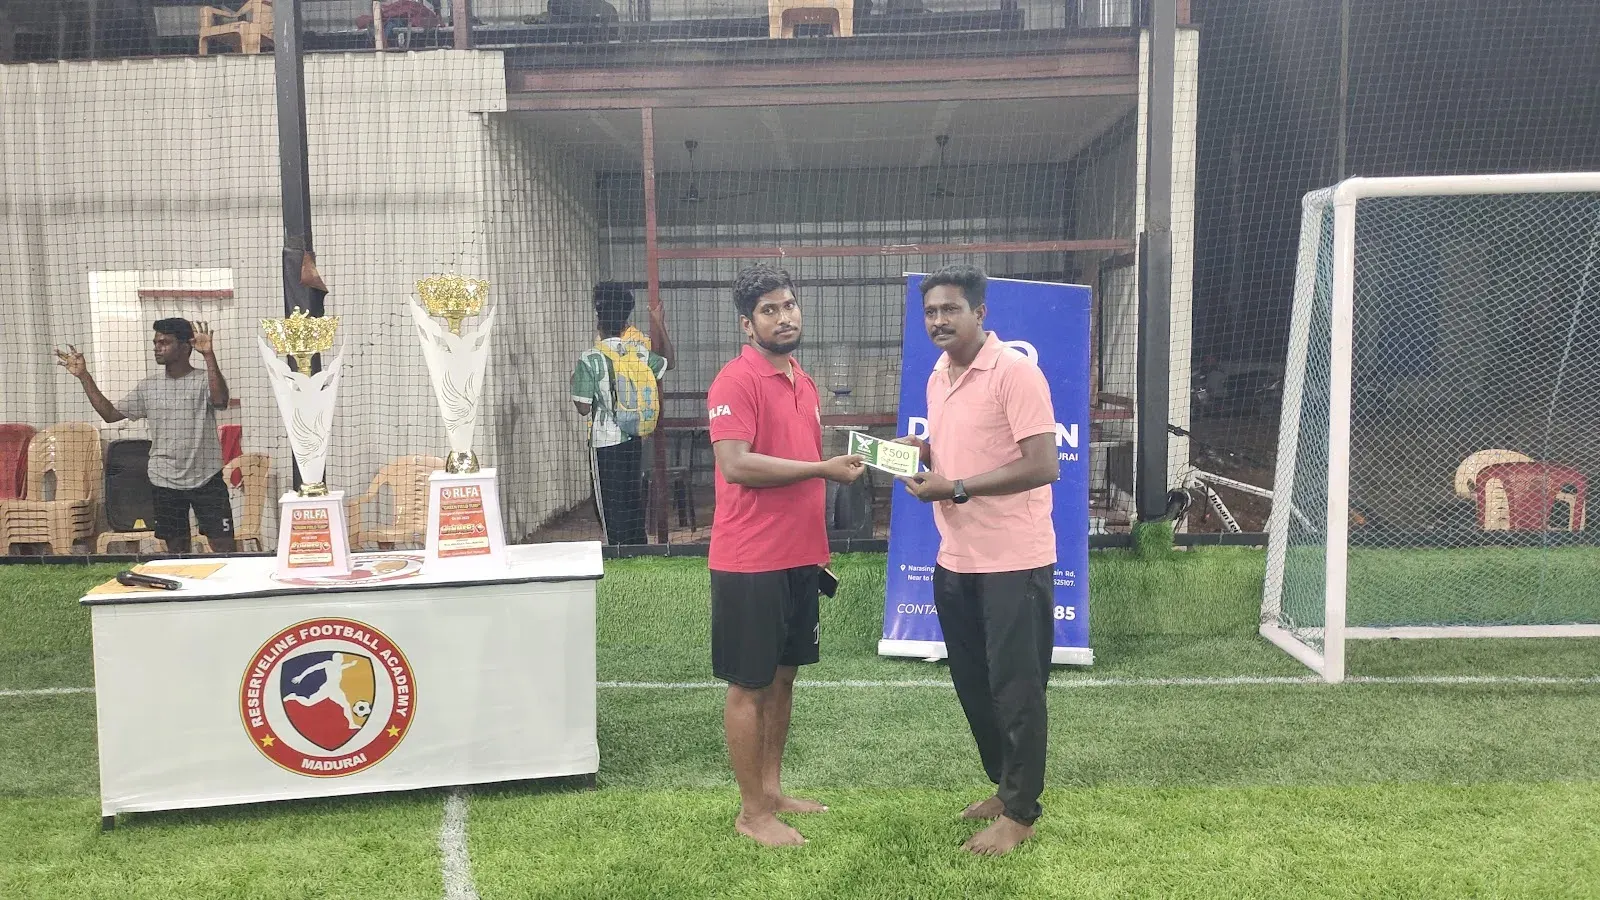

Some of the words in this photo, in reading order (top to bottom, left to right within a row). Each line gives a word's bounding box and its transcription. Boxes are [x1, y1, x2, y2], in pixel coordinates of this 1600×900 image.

[453, 486, 479, 497] RLFA
[303, 509, 328, 520] RLFA
[222, 518, 230, 532] 5
[908, 564, 935, 574] Narasing
[897, 603, 938, 615] CONTA
[1053, 605, 1076, 620] 85
[247, 634, 298, 728] RESERVELINE
[299, 624, 380, 651] FOOTBALL
[379, 649, 410, 718] ACADEMY
[301, 752, 368, 772] MADURAI
